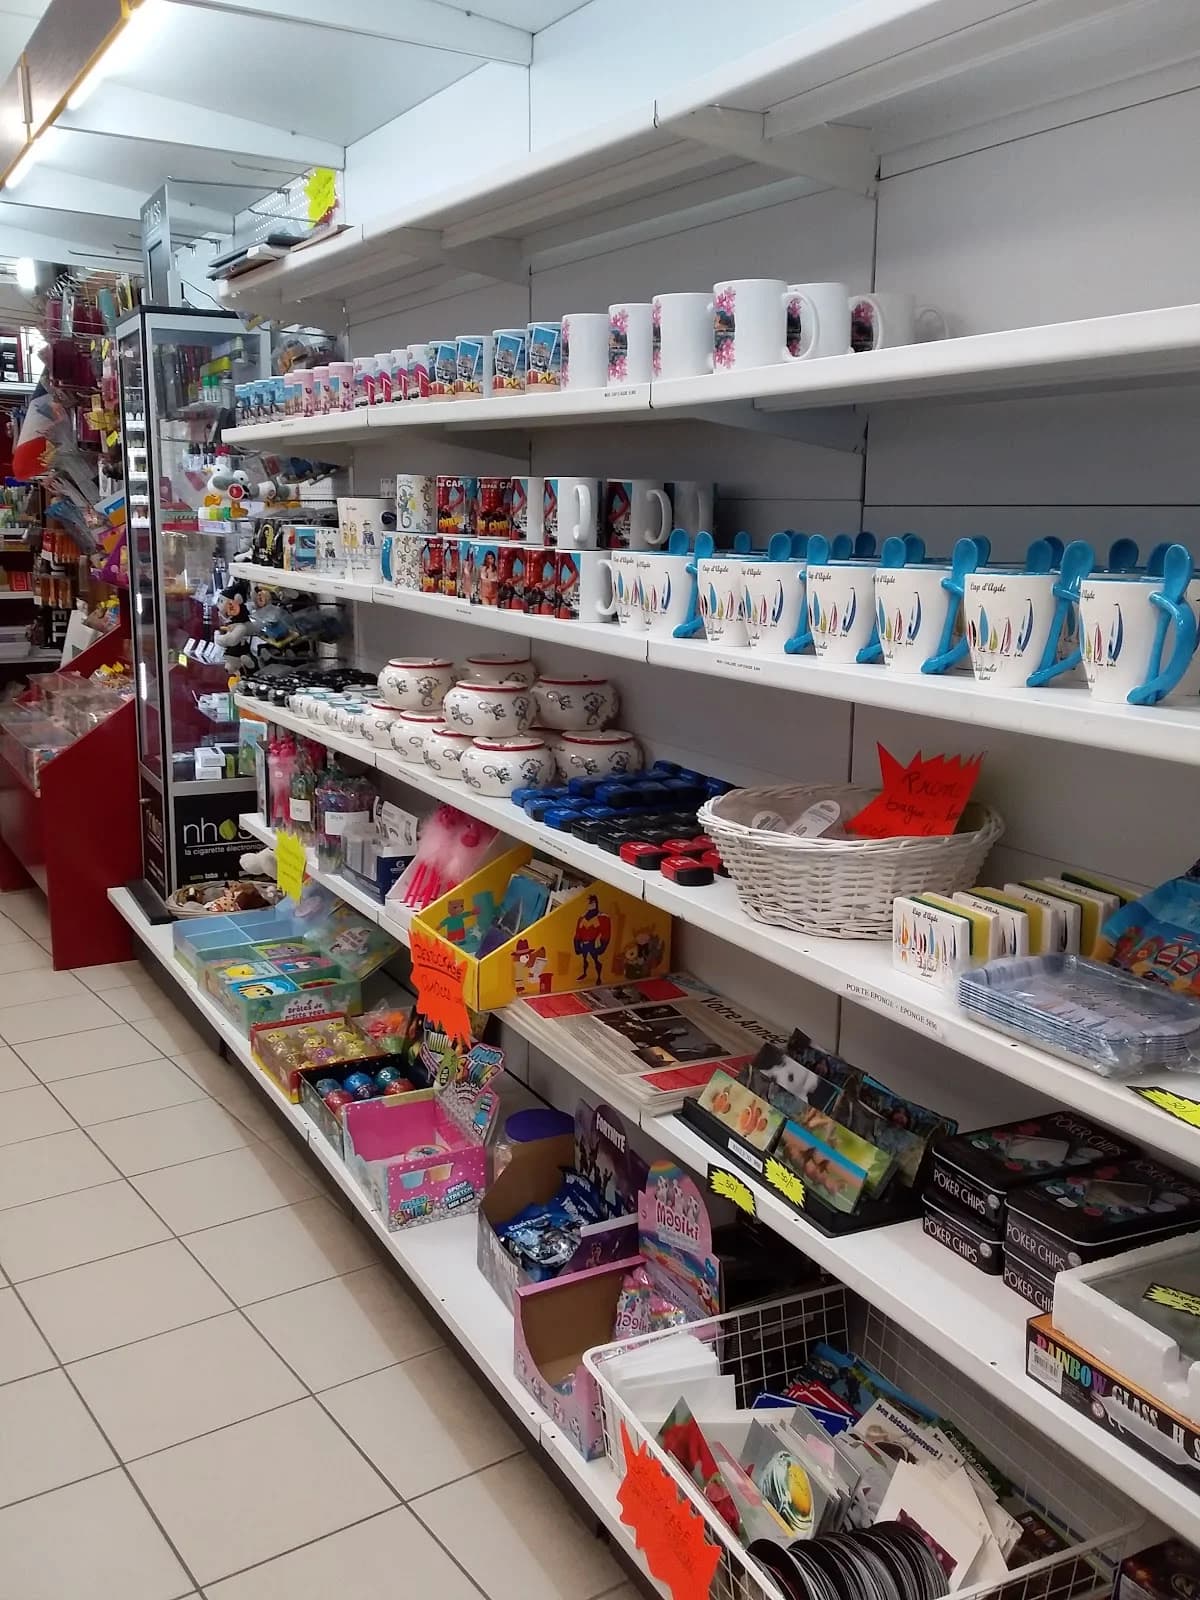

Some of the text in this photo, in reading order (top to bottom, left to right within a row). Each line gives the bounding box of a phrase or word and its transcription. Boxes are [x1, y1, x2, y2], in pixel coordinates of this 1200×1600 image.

[970, 582, 1007, 594] Cap d'Agde
[193, 845, 225, 856] cigarette
[701, 997, 739, 1024] Votre
[846, 983, 869, 996] PORTE
[870, 991, 894, 1009] EPONGE
[900, 1005, 925, 1024] EPONGE
[596, 1111, 626, 1154] FORTNITE
[934, 1168, 986, 1215] POKER CHIPS
[656, 1200, 699, 1241] Magiki
[924, 1216, 978, 1263] POKER CHIPS
[1006, 1222, 1065, 1272] POKER CHIPS
[1003, 1267, 1054, 1313] POKER CHI
[1036, 1333, 1108, 1395] RAINBOW
[875, 1403, 890, 1418] Bon
